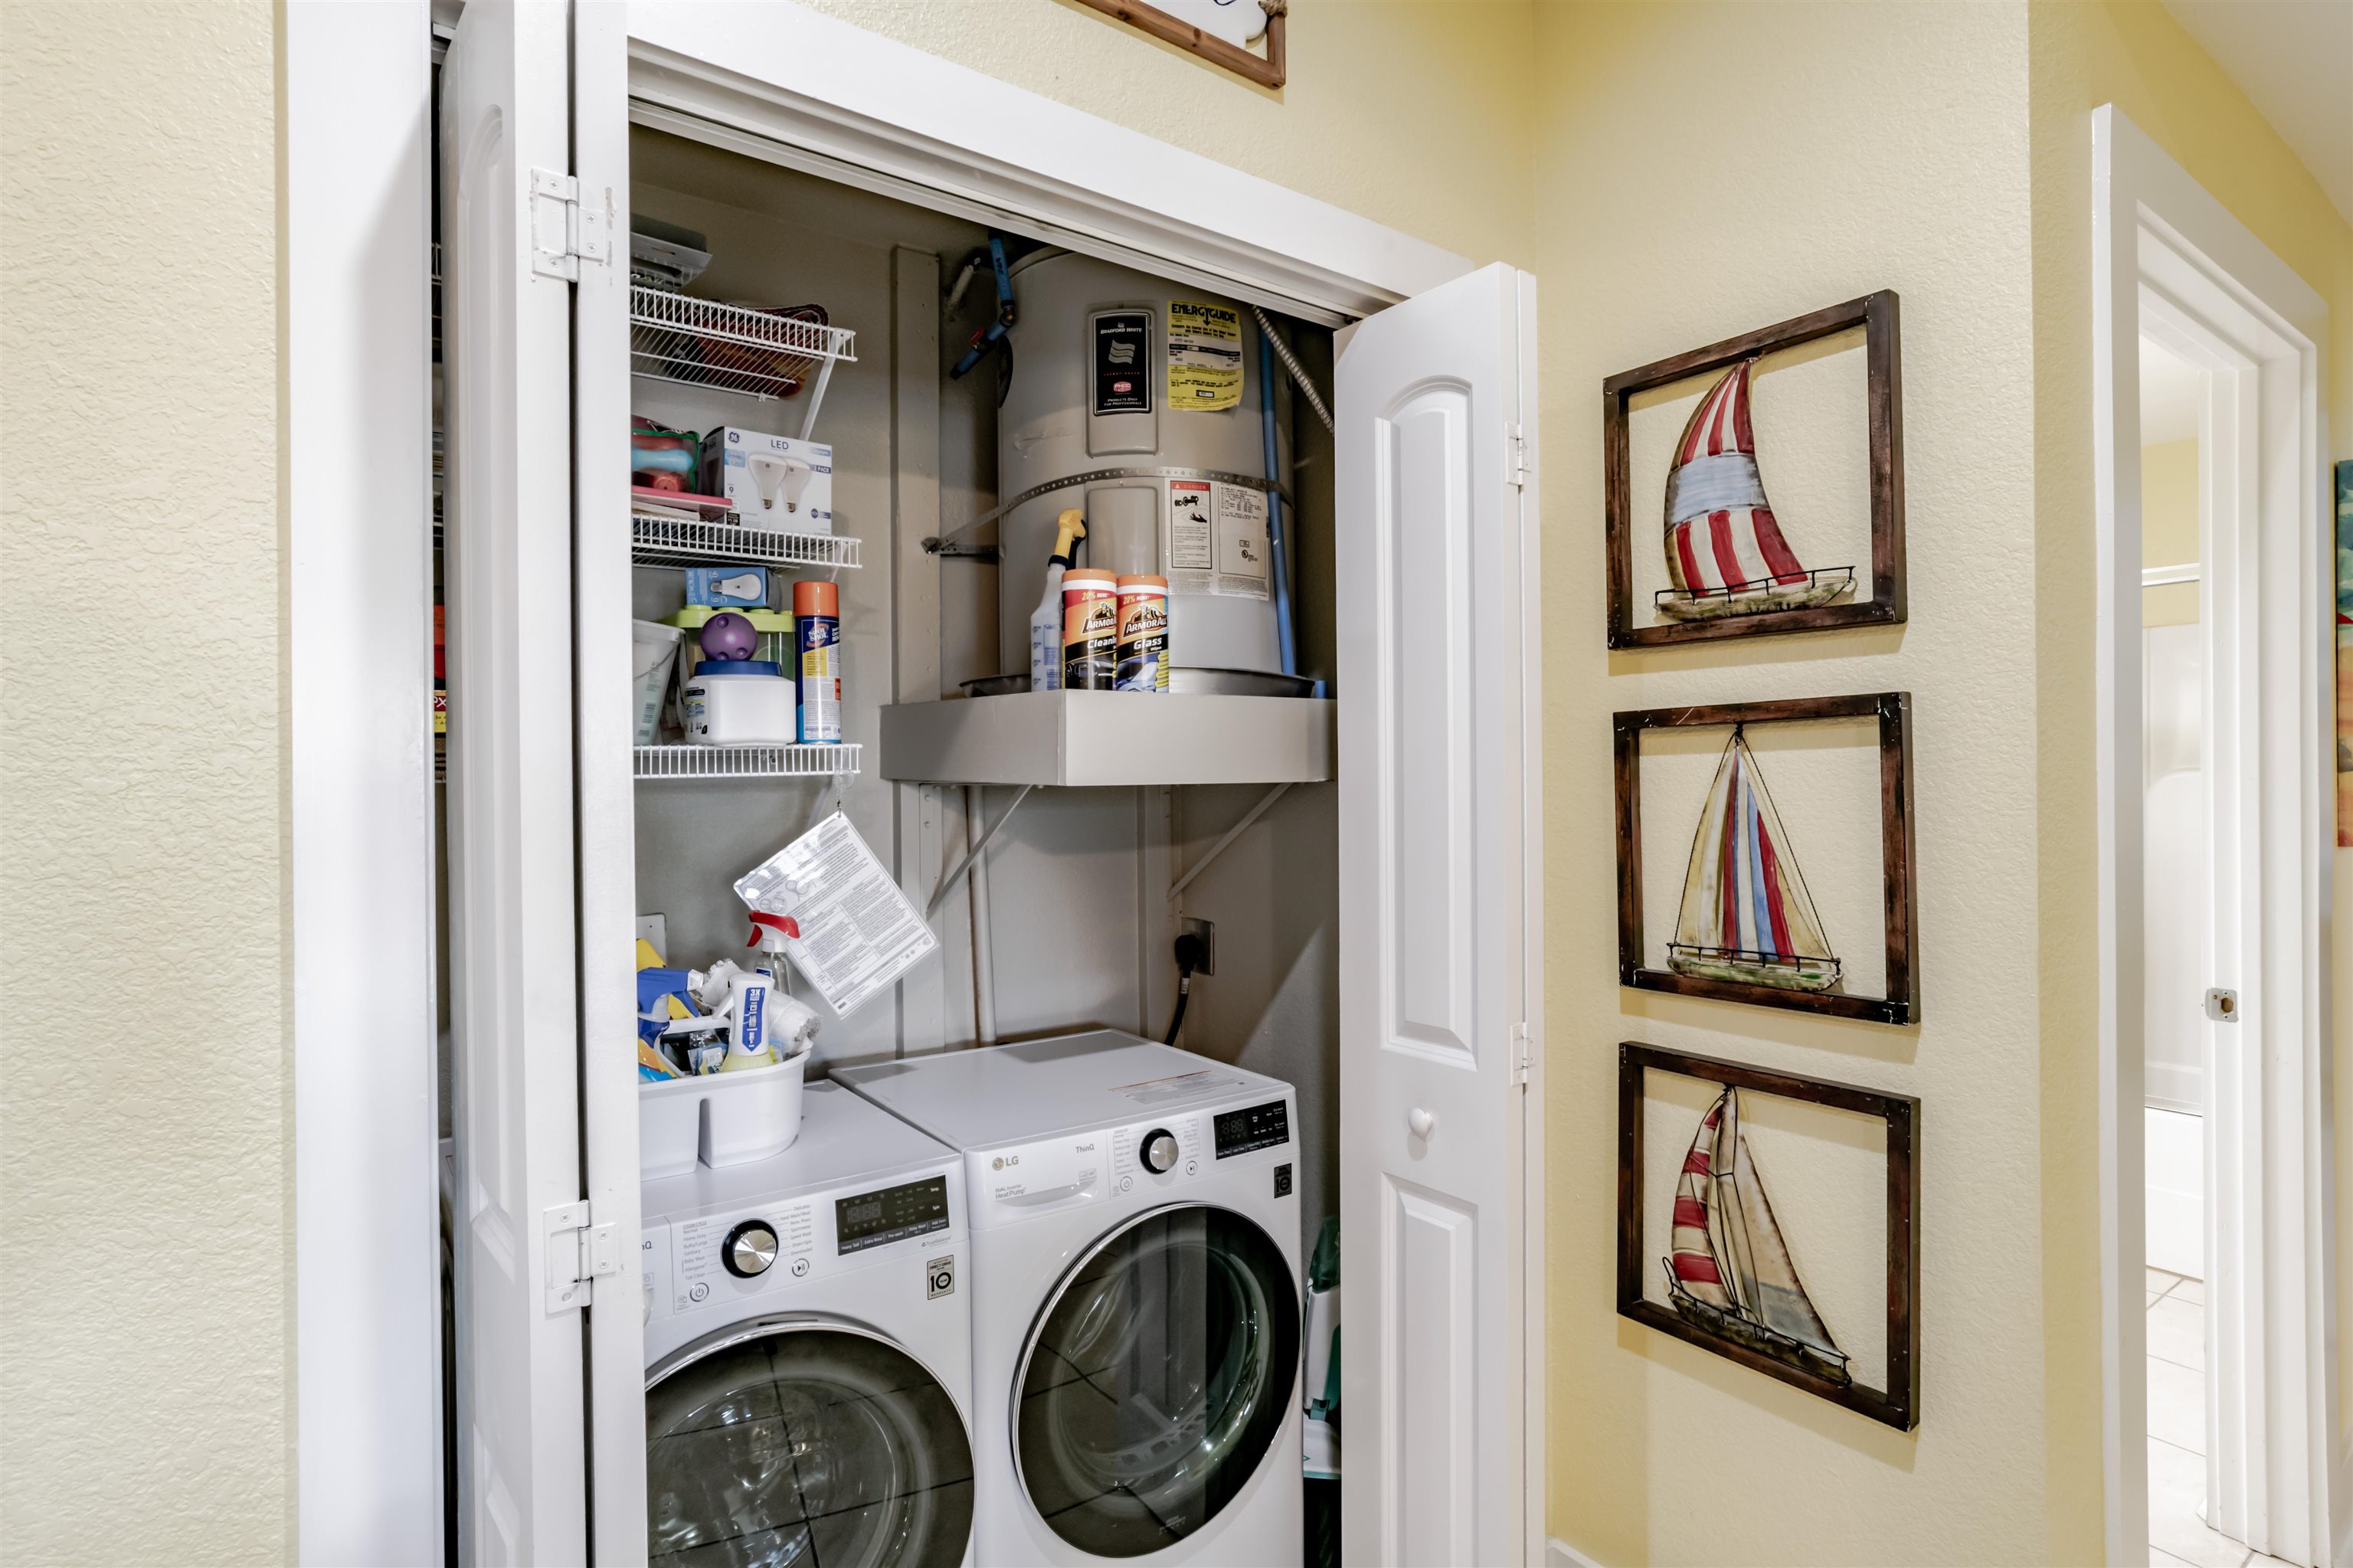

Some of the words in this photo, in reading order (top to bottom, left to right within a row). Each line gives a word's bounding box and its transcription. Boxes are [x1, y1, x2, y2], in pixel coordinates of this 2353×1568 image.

[771, 439, 789, 450] LED
[1082, 591, 1096, 601] 20%
[1124, 595, 1136, 604] 20%
[1134, 637, 1162, 650] Glass
[1075, 1144, 1095, 1154] ThinQ
[1006, 1156, 1019, 1167] LG
[996, 1190, 1009, 1199] Heat
[930, 1272, 952, 1292] 10
